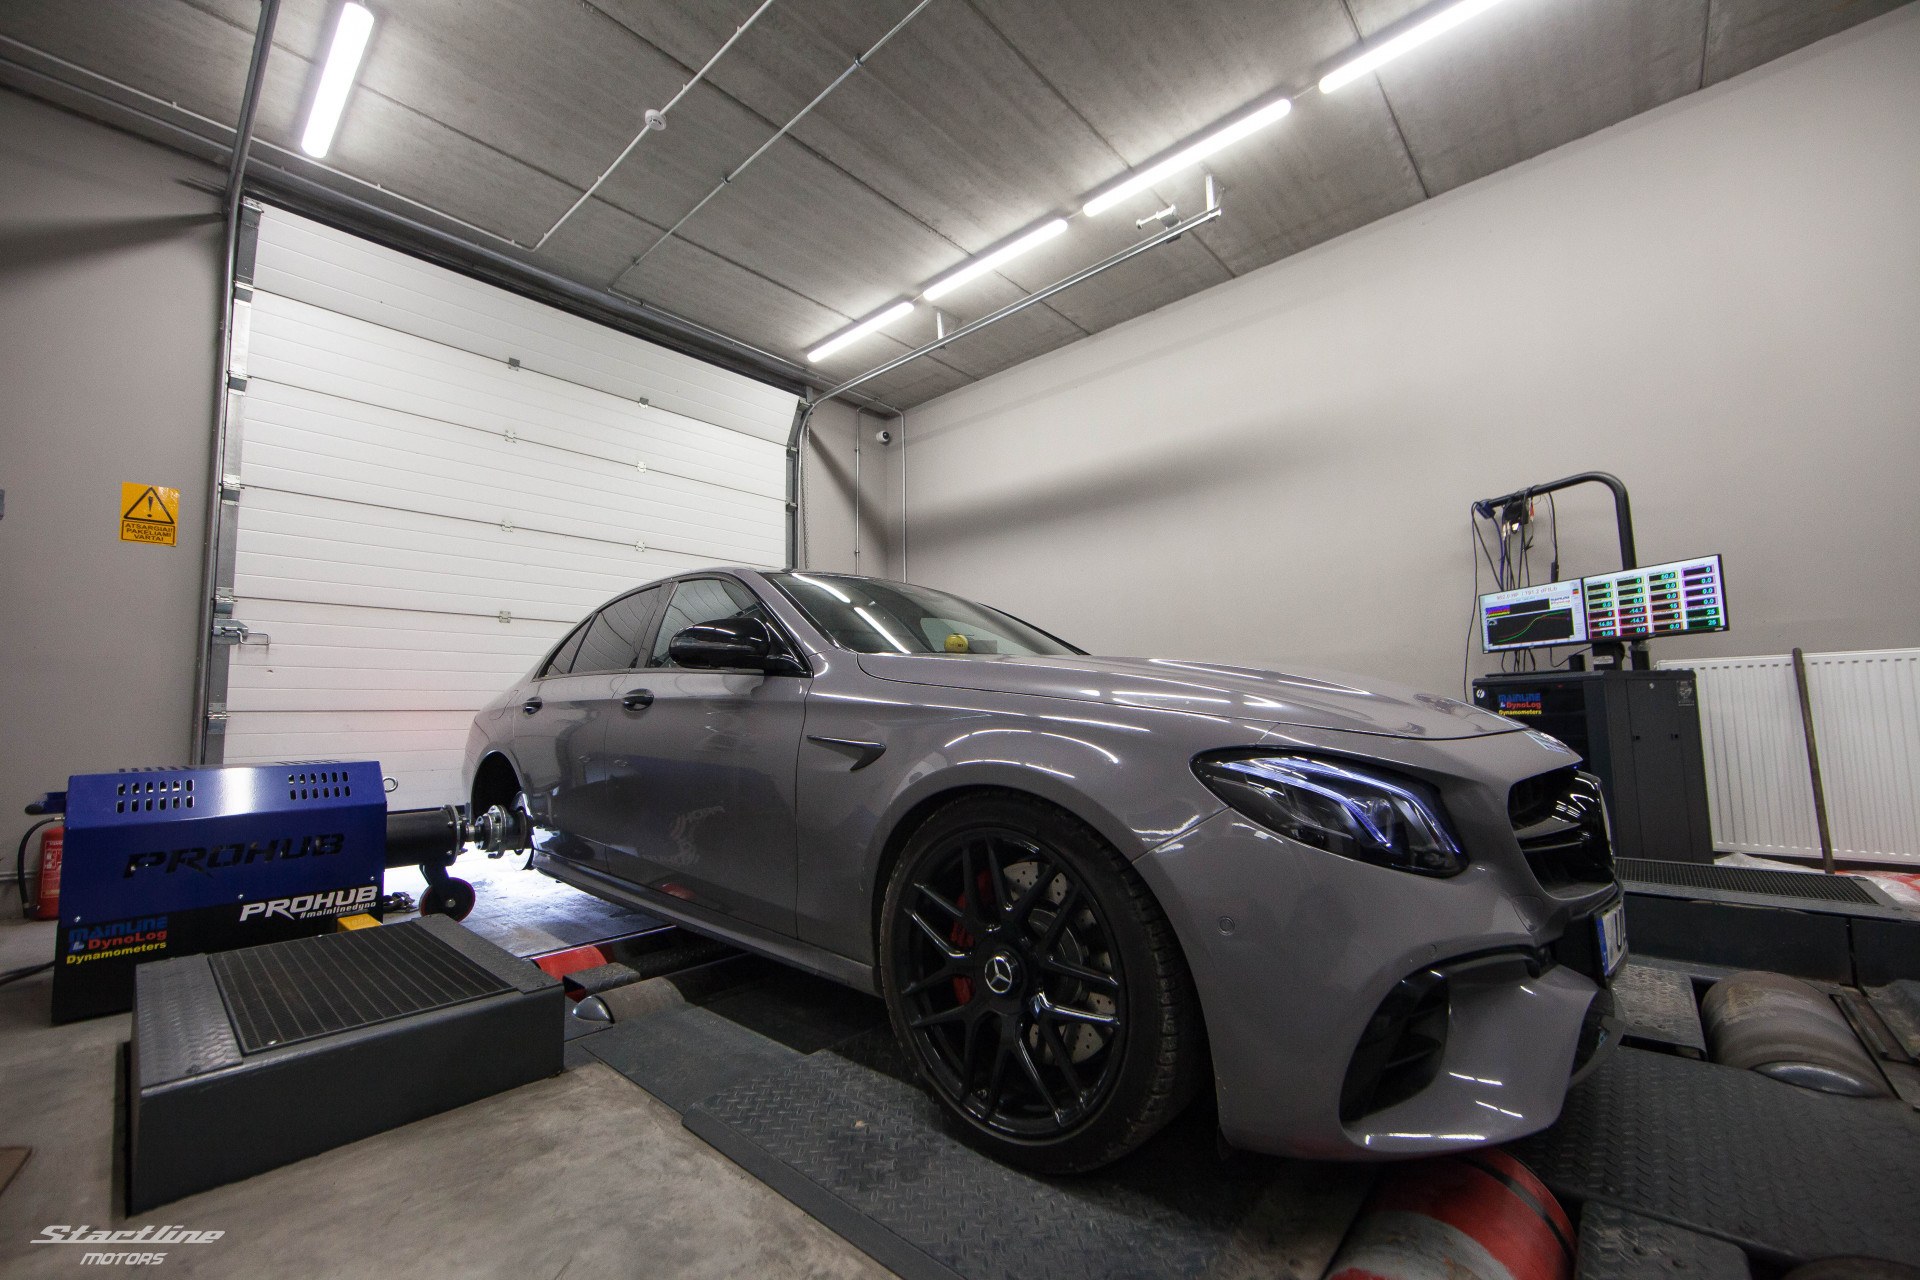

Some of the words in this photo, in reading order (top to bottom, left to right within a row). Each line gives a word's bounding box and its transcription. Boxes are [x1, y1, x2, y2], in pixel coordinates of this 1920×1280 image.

[126, 528, 171, 537] PAKELIAMI
[123, 833, 345, 879] PROHUB
[239, 886, 378, 922] PROHUB
[300, 901, 377, 919] #mainlinedyno
[88, 930, 167, 950] DynoLog
[66, 942, 166, 965] Dynamometers
